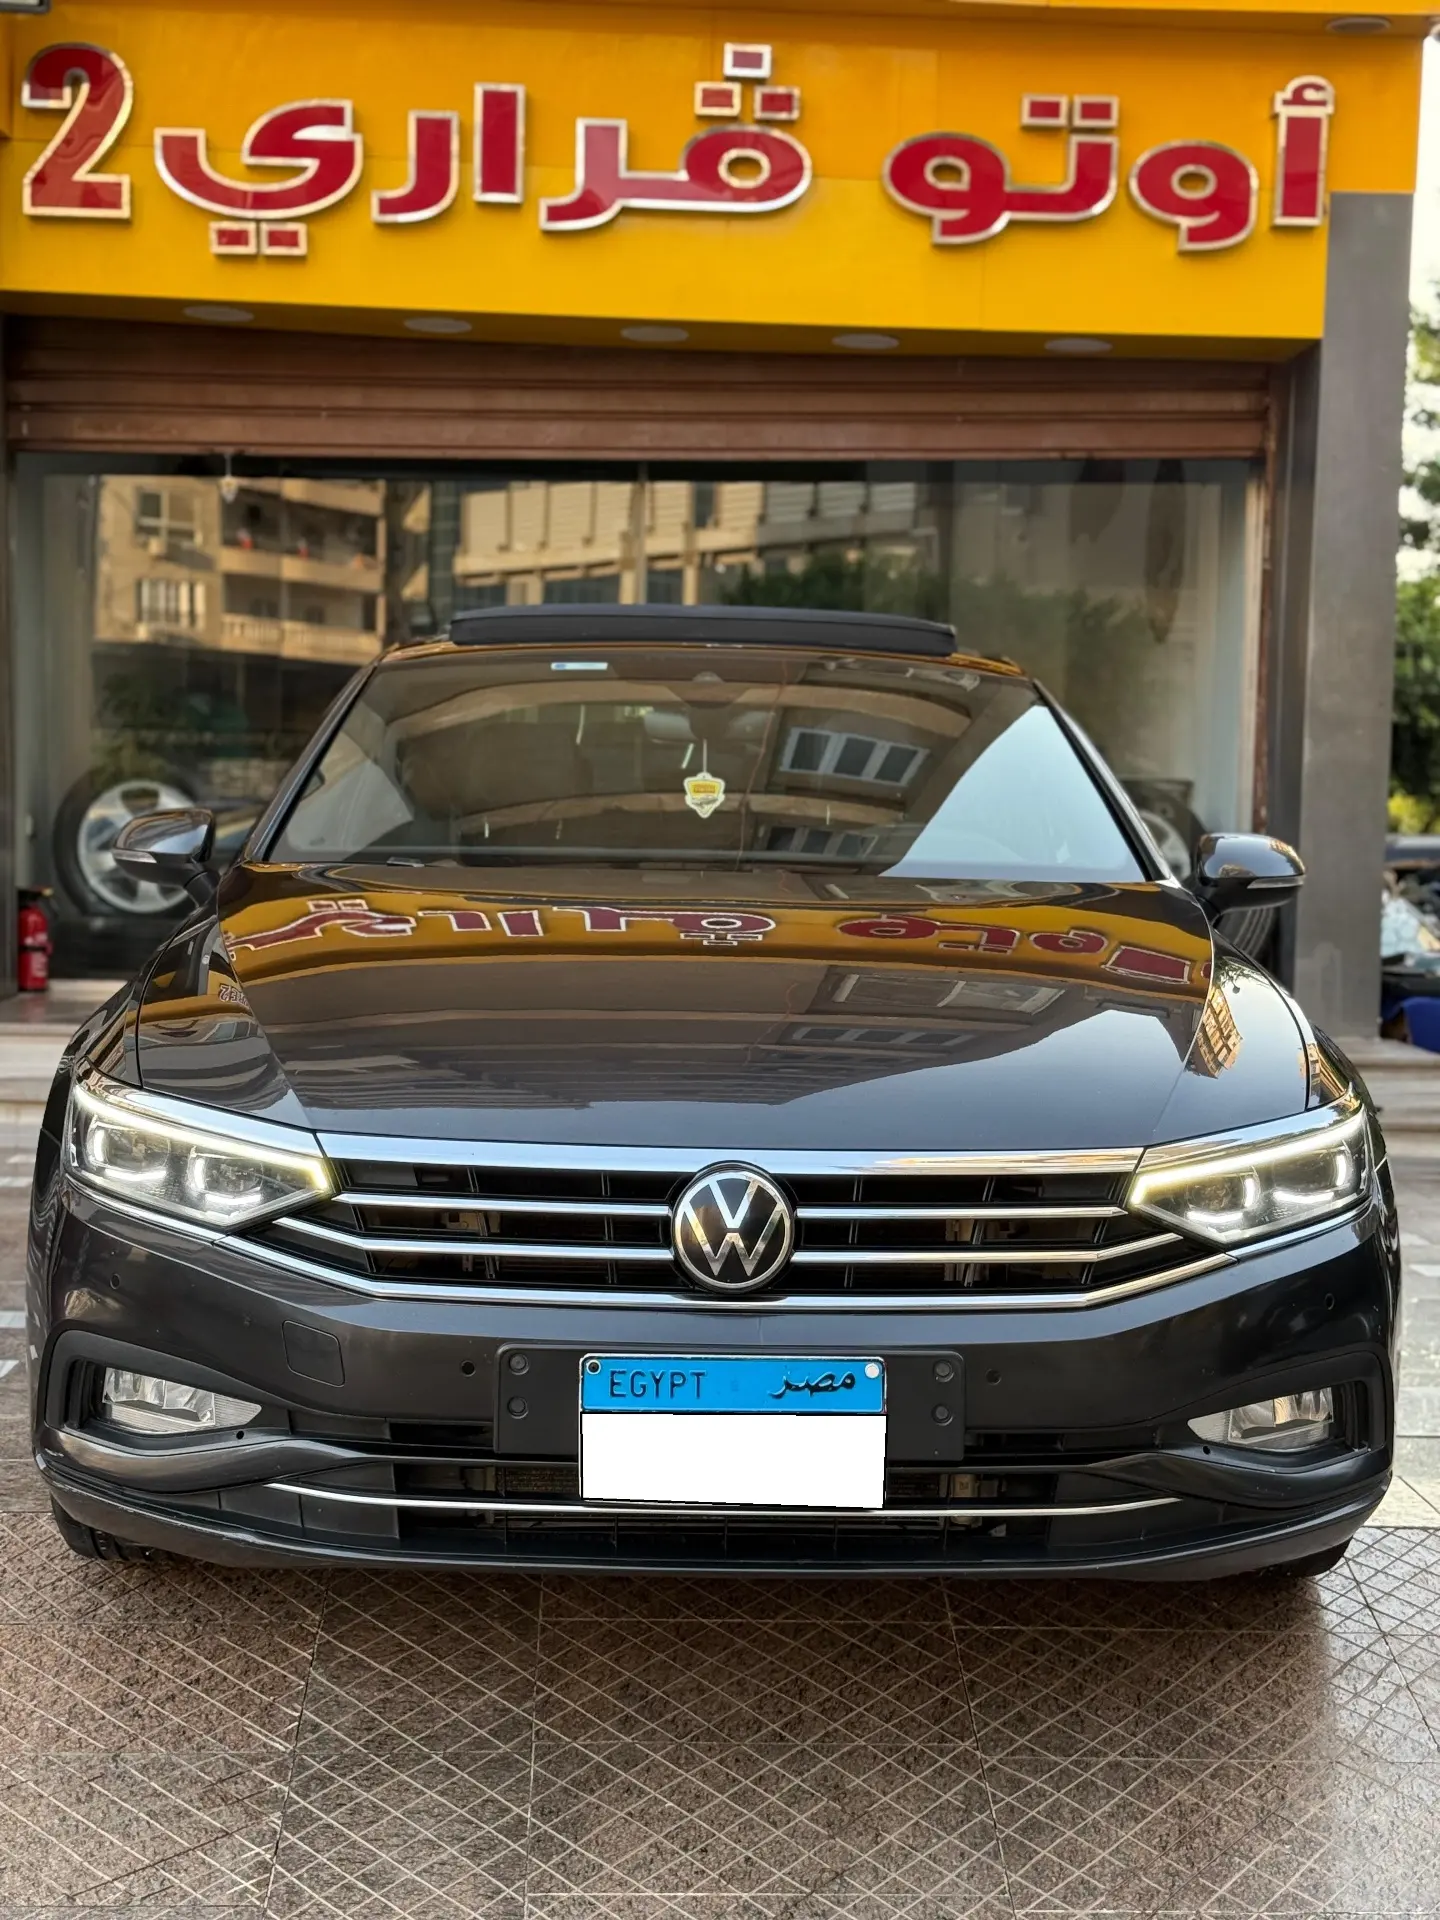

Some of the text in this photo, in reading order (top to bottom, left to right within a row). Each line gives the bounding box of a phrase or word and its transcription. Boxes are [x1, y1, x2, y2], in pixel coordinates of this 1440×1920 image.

[22, 42, 134, 219] 2
[882, 75, 1335, 252] أوتو
[608, 1368, 708, 1399] EGYPT
[767, 1370, 856, 1400] مصر
